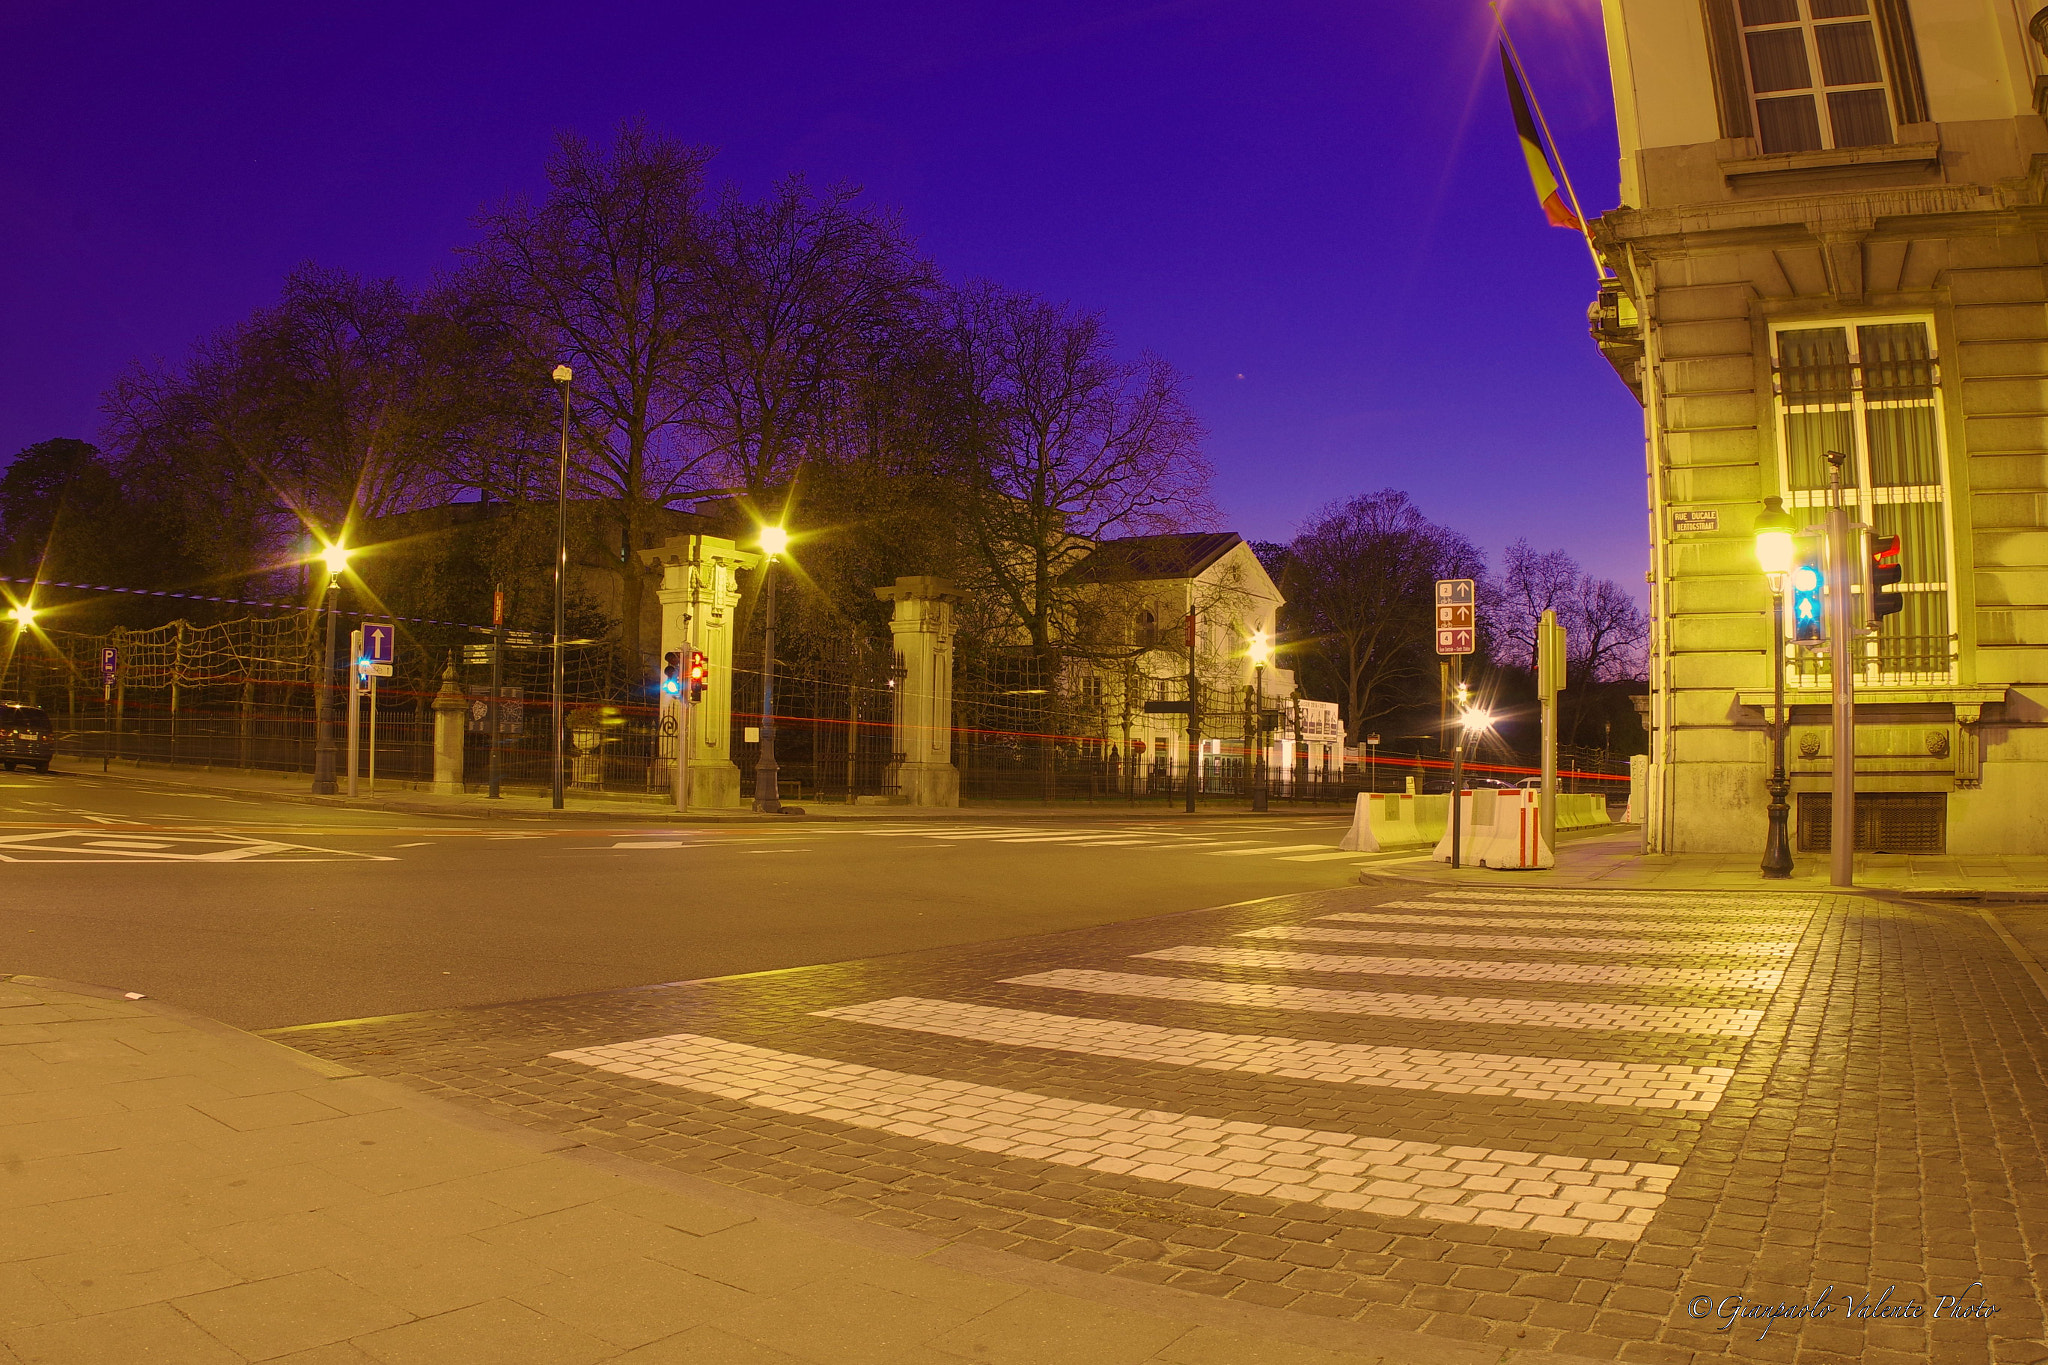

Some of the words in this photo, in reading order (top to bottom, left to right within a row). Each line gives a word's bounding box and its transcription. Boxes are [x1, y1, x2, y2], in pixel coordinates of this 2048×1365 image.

[1674, 512, 1688, 521] RUE
[1691, 511, 1716, 520] DUCALE
[105, 650, 113, 663] P
